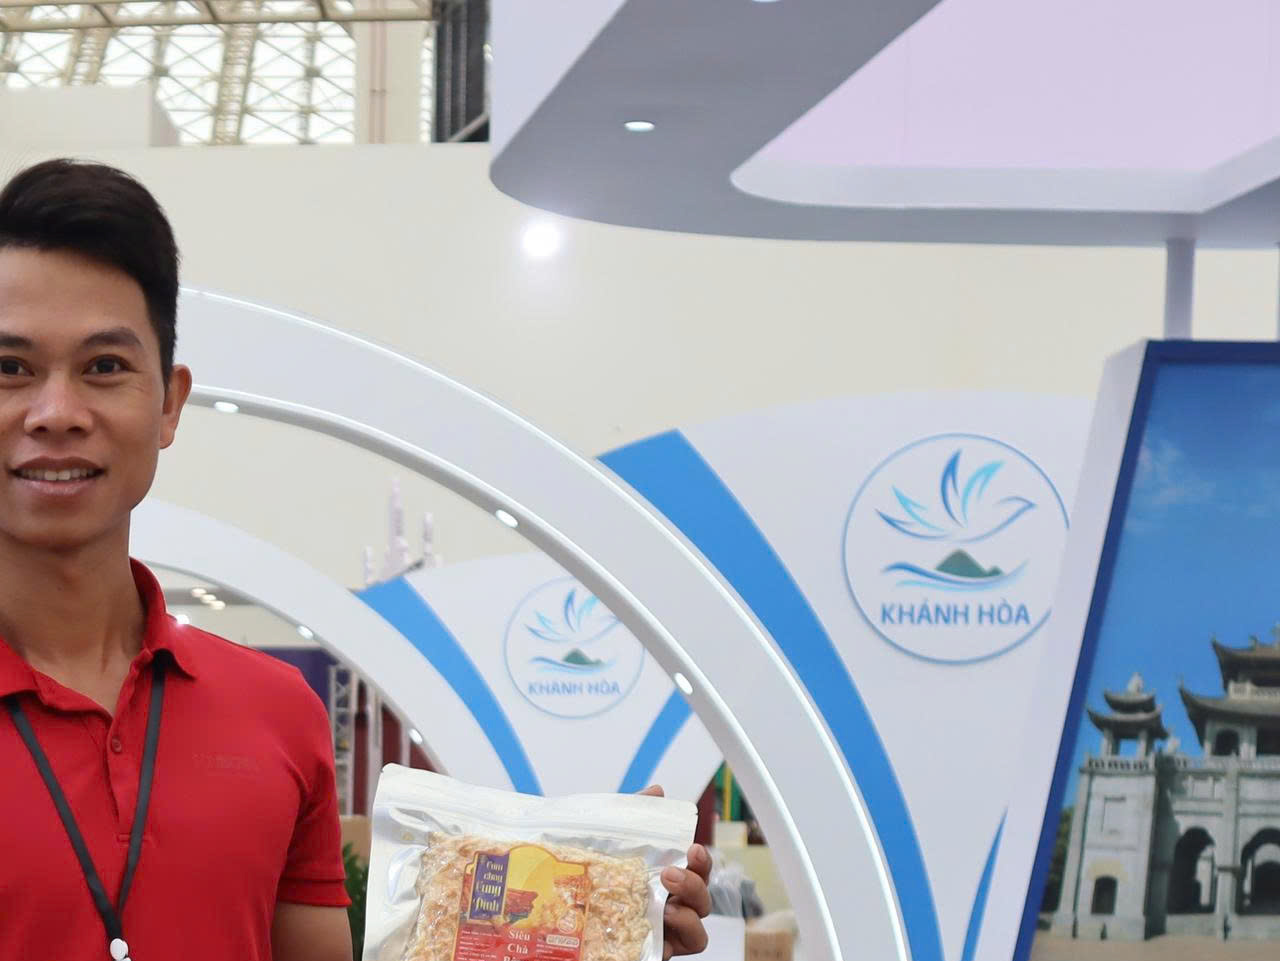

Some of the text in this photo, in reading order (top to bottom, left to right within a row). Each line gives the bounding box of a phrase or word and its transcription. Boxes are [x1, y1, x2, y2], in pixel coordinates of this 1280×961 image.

[880, 597, 1031, 625] KHÁNH HÒA
[528, 679, 620, 695] KHÁNH HÒA
